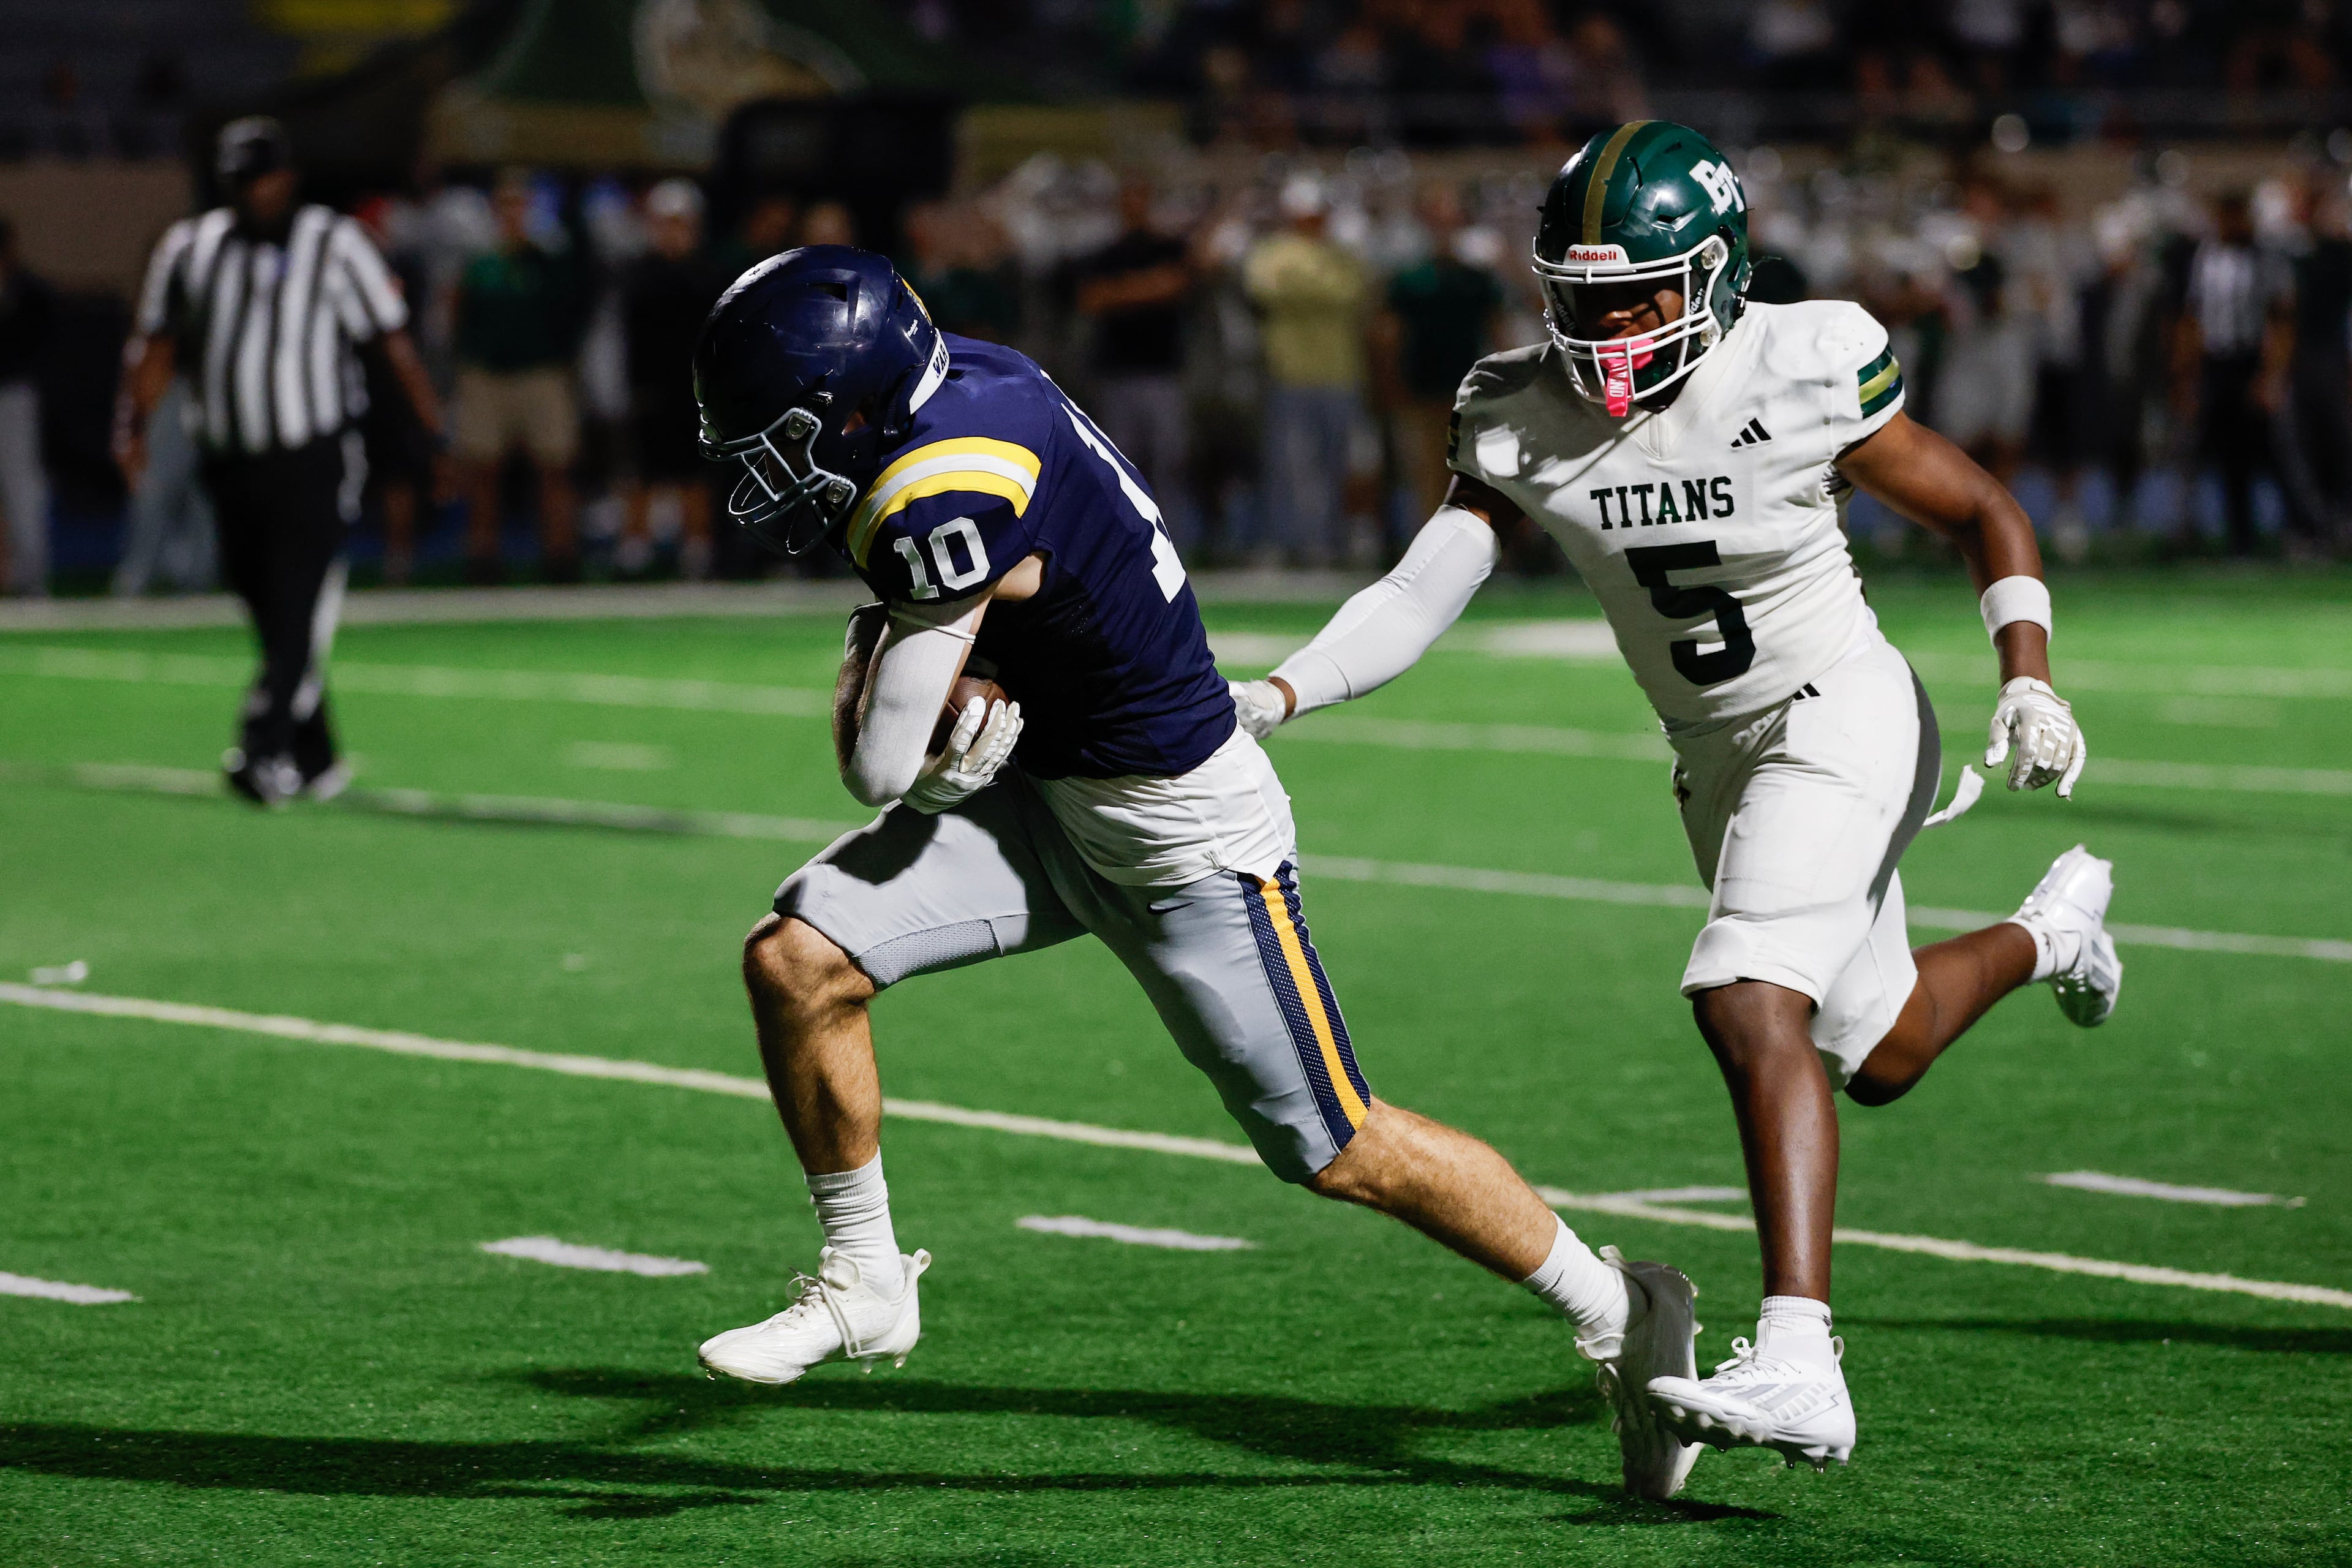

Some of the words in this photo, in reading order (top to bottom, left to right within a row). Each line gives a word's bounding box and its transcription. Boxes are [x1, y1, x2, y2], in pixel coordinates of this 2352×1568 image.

[1689, 159, 1745, 216] BT
[1569, 250, 1618, 261] Riddell
[1589, 475, 1735, 530] TITANS
[893, 516, 991, 601] 10
[1624, 540, 1757, 686] 5
